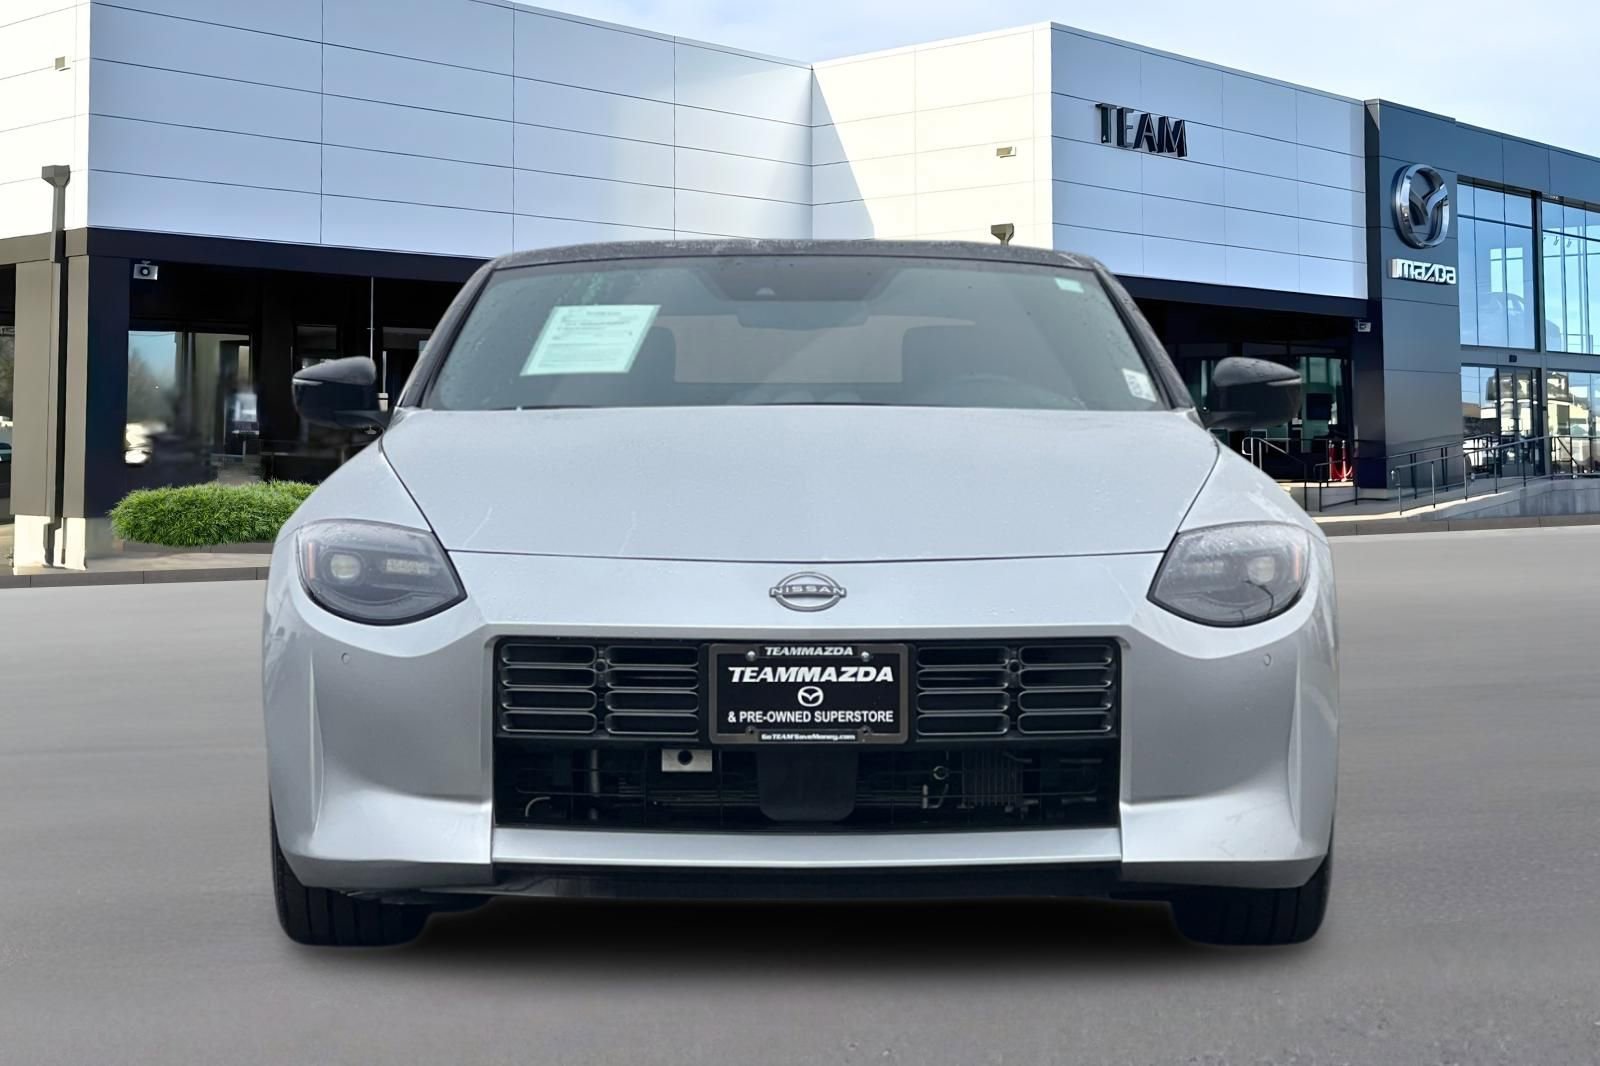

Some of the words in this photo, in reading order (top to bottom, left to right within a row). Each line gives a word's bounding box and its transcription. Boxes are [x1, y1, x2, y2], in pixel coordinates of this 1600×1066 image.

[1095, 102, 1187, 158] TEAM
[771, 585, 845, 596] NISSAN
[765, 646, 853, 656] TEAMMAZDA
[728, 666, 894, 683] TEAMMAZDA
[728, 711, 736, 723] &
[739, 711, 811, 723] PRE-OWNED
[814, 711, 894, 723] SUPERSTORE
